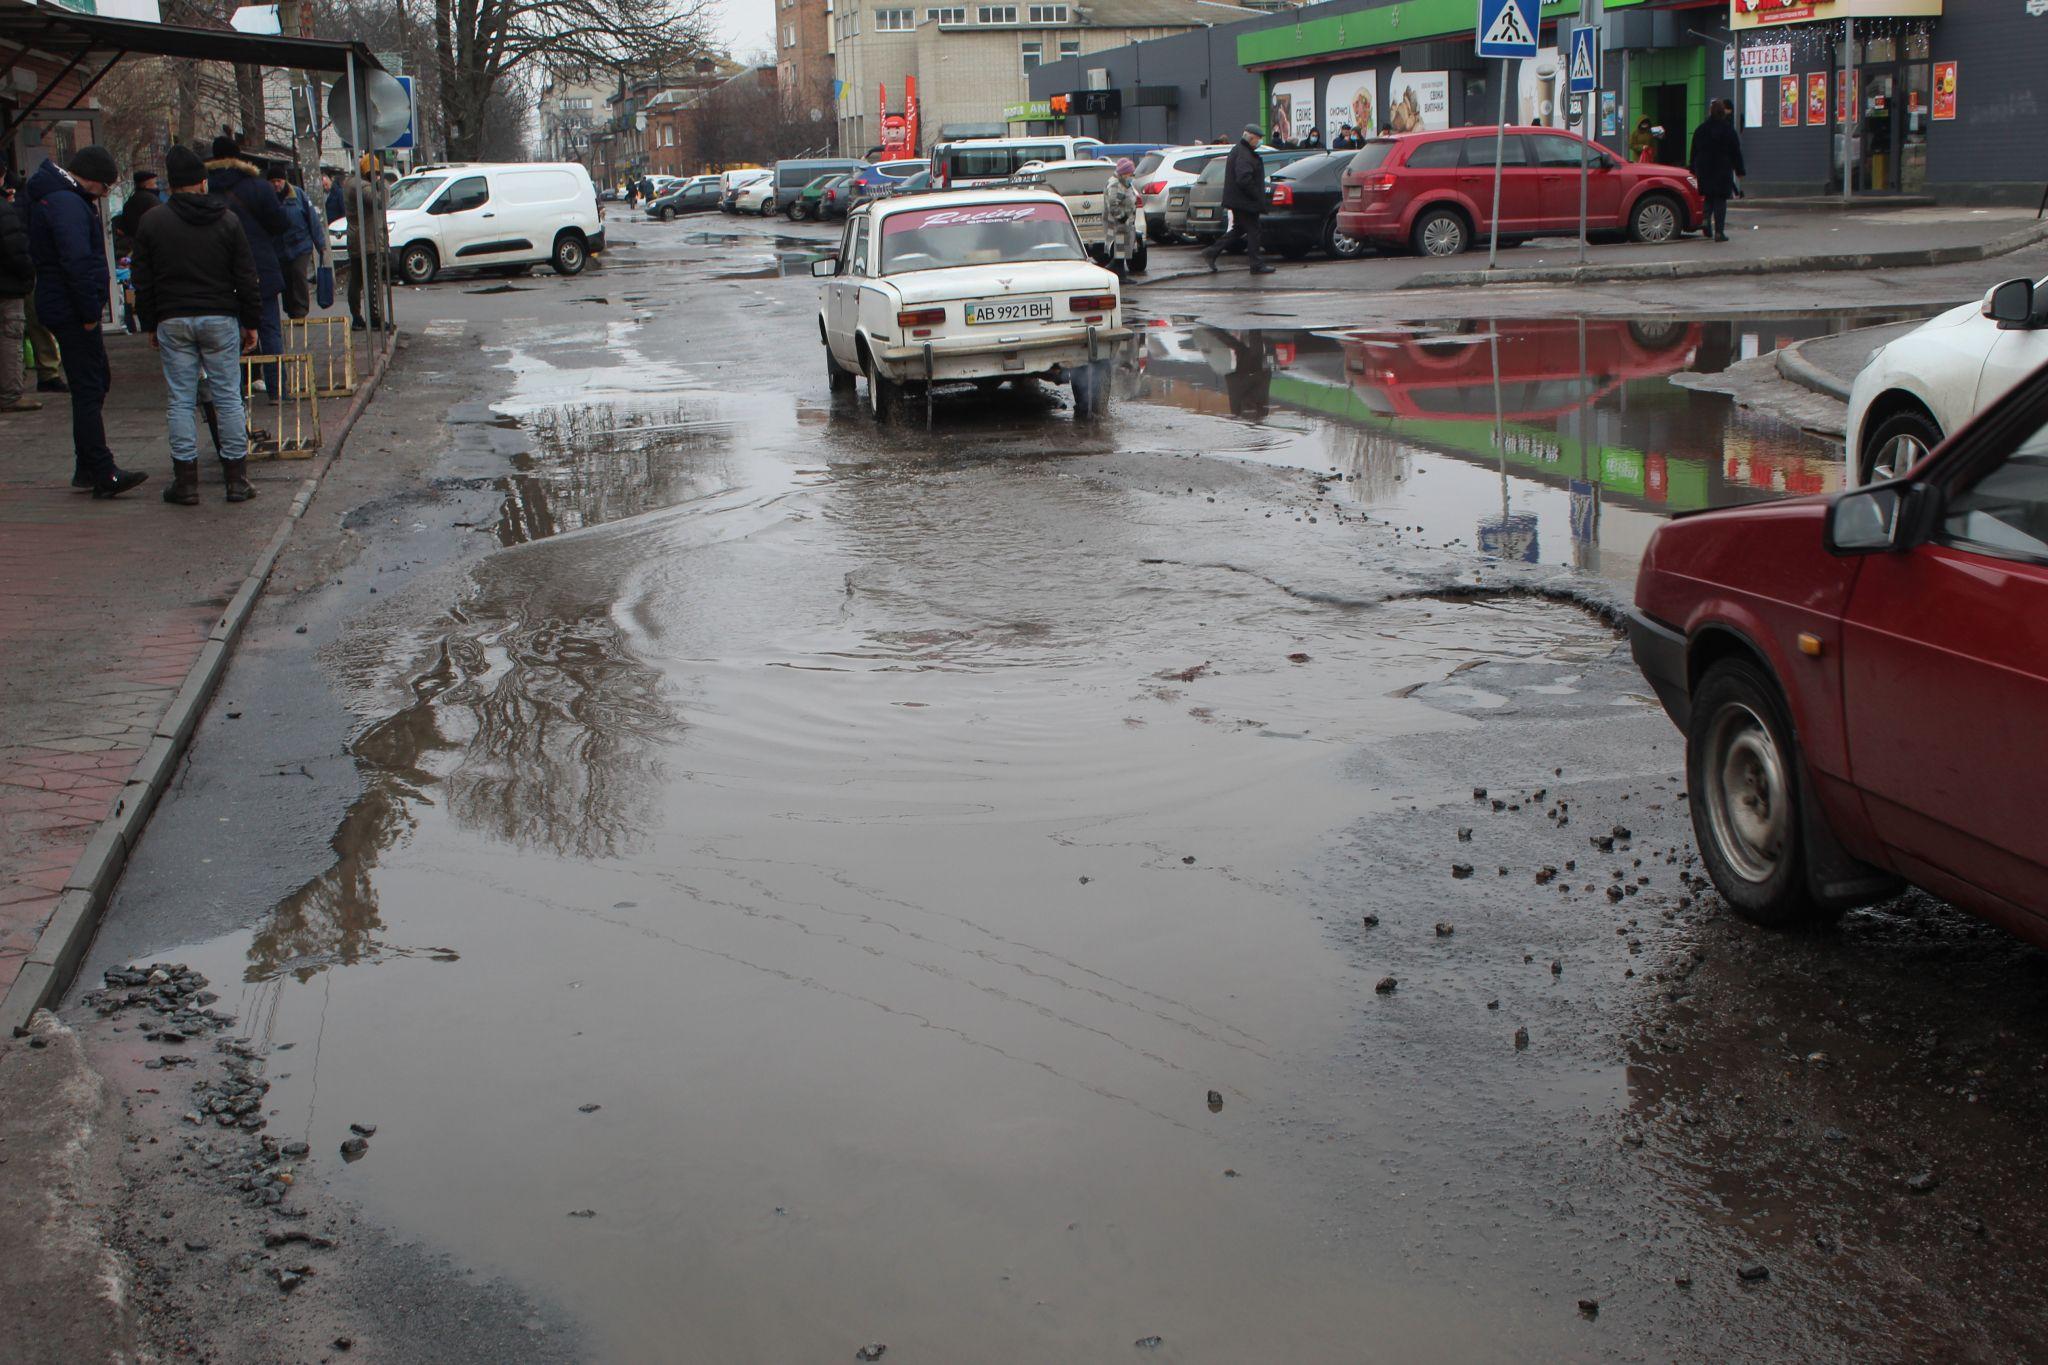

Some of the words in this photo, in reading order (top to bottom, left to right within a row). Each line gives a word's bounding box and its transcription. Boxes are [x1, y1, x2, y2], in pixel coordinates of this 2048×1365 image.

[1741, 47, 1788, 66] АПТЕКА
[918, 207, 1036, 230] Racing
[976, 307, 995, 321] AB
[998, 304, 1027, 319] 9921
[1030, 303, 1050, 317] BH
